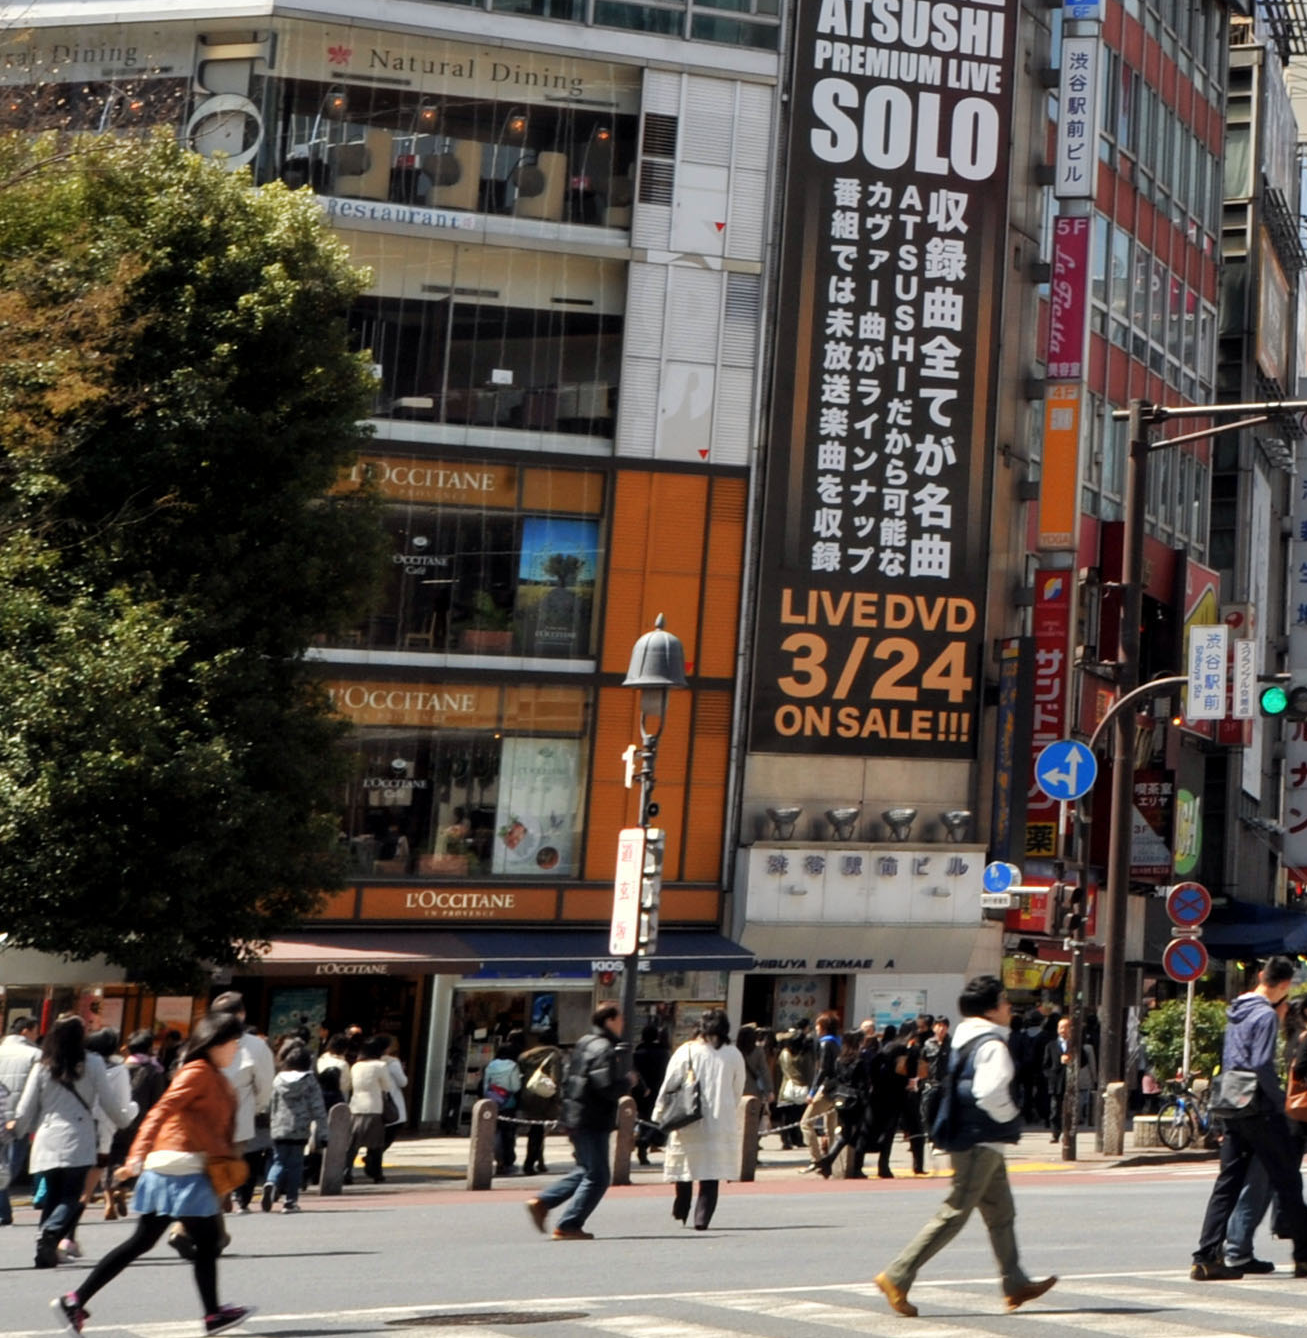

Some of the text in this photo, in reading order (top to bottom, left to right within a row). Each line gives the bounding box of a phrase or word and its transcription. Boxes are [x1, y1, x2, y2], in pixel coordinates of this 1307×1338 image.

[52, 44, 138, 68] Dining
[369, 47, 586, 96] Natural Dining
[814, 39, 1003, 95] PREMIUM LIVE
[810, 77, 1000, 182] SOLO
[1064, 51, 1090, 184] 渋谷駅前ビル
[326, 198, 463, 229] Restaurant
[1056, 219, 1088, 236] 5F
[811, 176, 863, 574] 番組では未放送楽曲を収録
[846, 180, 894, 574] カヴァー曲がラインナップ
[877, 184, 924, 578] ATSUSHIだから可能な
[909, 188, 970, 580] 収録曲全てが名曲
[780, 588, 977, 634] LIVE DVD
[776, 631, 973, 704] 3/24
[1204, 633, 1221, 711] 渋谷駅前
[328, 685, 476, 713] L'OCCITANE
[774, 704, 971, 743] ON SALE!!!
[1027, 824, 1052, 854] 薬
[766, 854, 970, 880] 渋谷駅前ビル
[405, 889, 516, 910] L'OCCITANE
[315, 962, 389, 976] L'OCCITANE
[815, 956, 874, 971] EKIMAE
